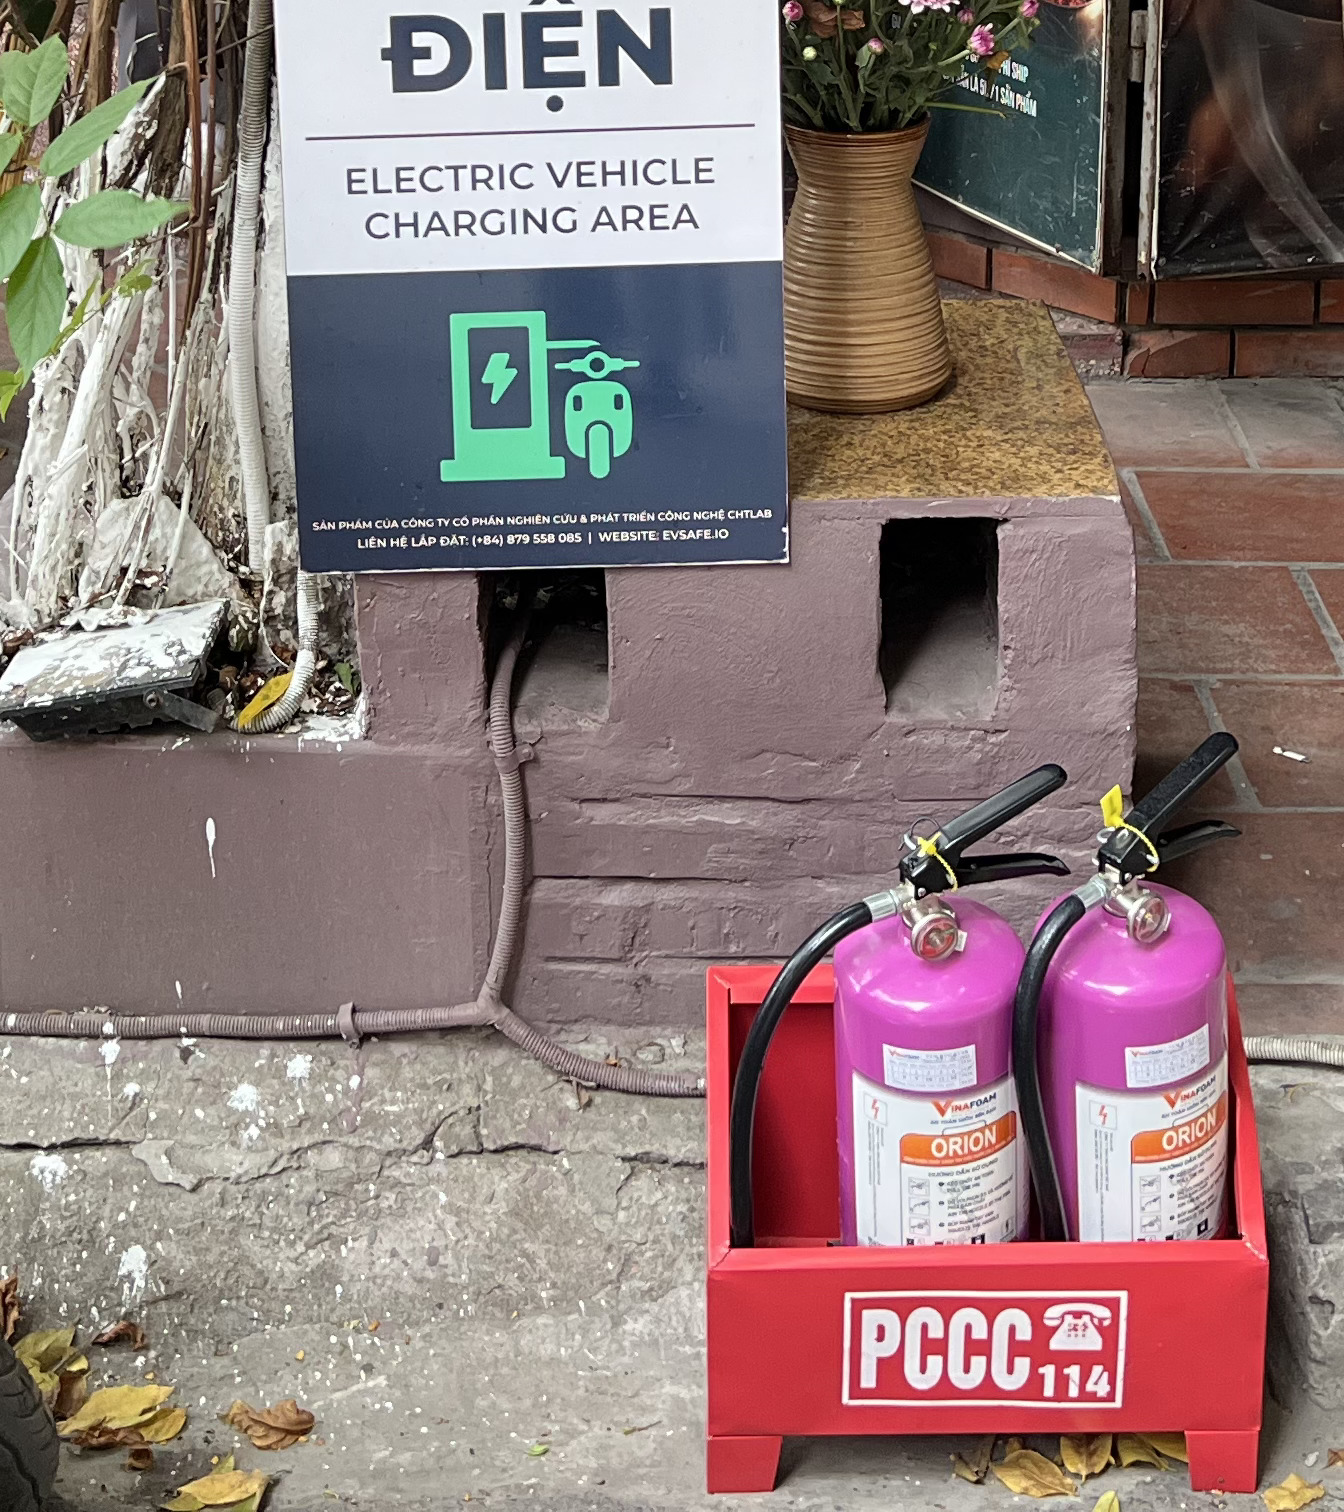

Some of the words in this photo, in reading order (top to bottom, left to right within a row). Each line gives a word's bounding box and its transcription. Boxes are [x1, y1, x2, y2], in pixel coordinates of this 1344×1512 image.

[345, 161, 536, 196] ELECTRIC
[545, 156, 716, 190] VEHICLE
[364, 204, 579, 240] CHARGING
[590, 202, 700, 234] AREA
[312, 517, 336, 532] SẢN
[338, 516, 373, 531] PHẨM
[374, 516, 399, 530] CỦA
[400, 515, 435, 530] CÔNG
[436, 518, 451, 528] TY
[452, 513, 470, 528] CỔ
[471, 514, 504, 527] PHẦN
[506, 513, 551, 526] NGHIÊN
[552, 512, 577, 525] CỨU
[579, 514, 588, 524] &
[590, 511, 620, 524] PHÁT
[622, 509, 656, 523] TRIỂN
[657, 508, 692, 522] CÔNG
[693, 507, 726, 522] NGHỆ
[727, 508, 773, 521] CHTLAB
[357, 534, 388, 550] LIÊN
[389, 534, 409, 551] HỆ
[410, 532, 437, 548] LẮP
[471, 533, 505, 548] (+84)
[506, 533, 531, 545] 879
[532, 532, 556, 545] 558
[558, 532, 583, 544] 085
[599, 530, 661, 543] WEBSITE:
[662, 528, 730, 541] EVSAFE.IO
[930, 1091, 998, 1119] VINAFOAM
[1162, 1074, 1217, 1109] VINAFOAM
[930, 1124, 997, 1159] ORION
[1161, 1107, 1217, 1151] ORION
[860, 1306, 1033, 1391] PCCC
[1037, 1363, 1112, 1399] 114
